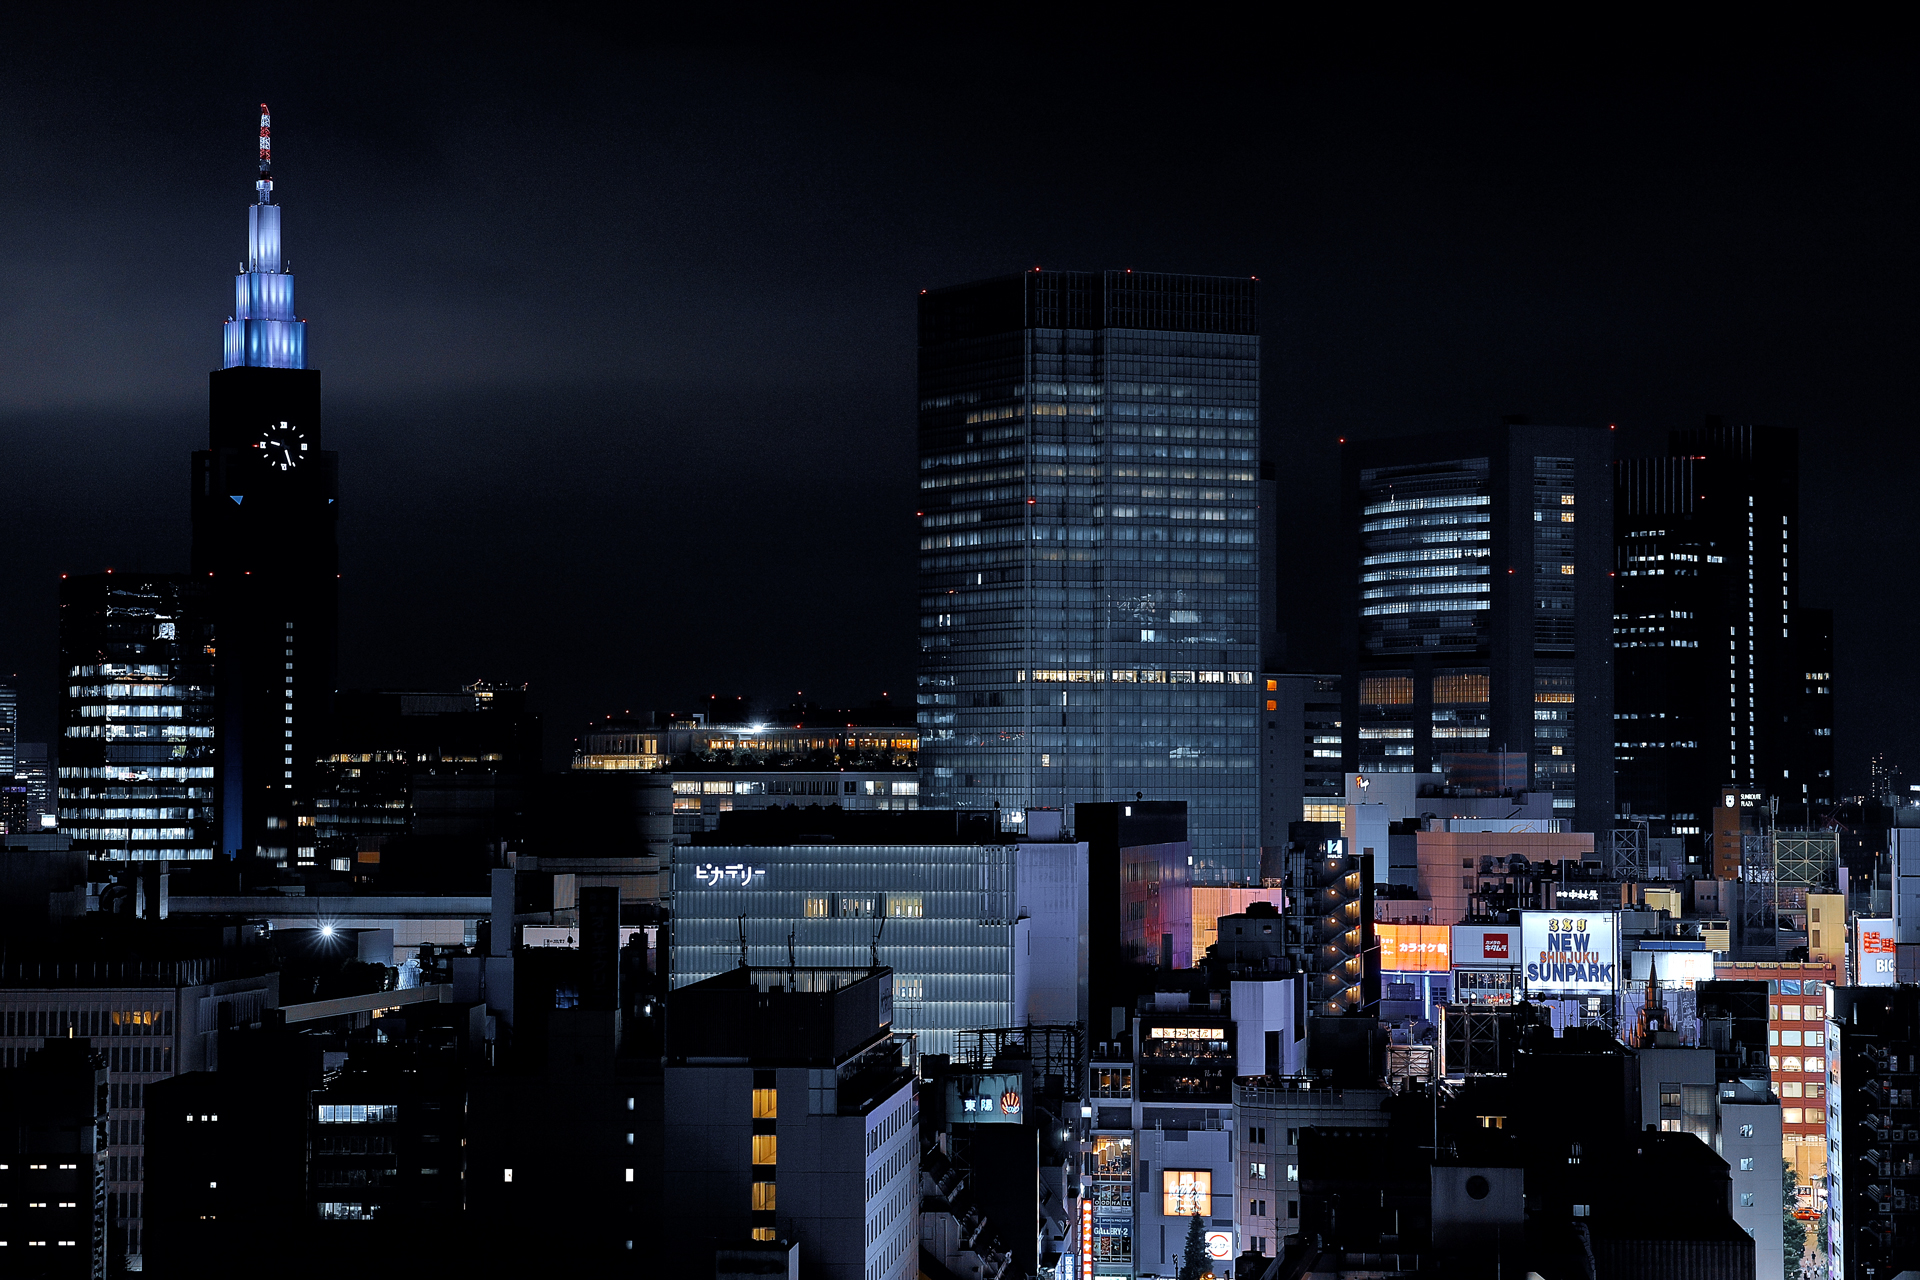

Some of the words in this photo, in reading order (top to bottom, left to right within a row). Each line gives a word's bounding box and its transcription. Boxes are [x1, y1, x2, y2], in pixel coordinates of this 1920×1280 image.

[696, 863, 766, 887] ピカデリー
[1547, 933, 1591, 952] NEW
[1539, 951, 1599, 964] SHINJUKU
[1527, 962, 1613, 983] SUNPARK
